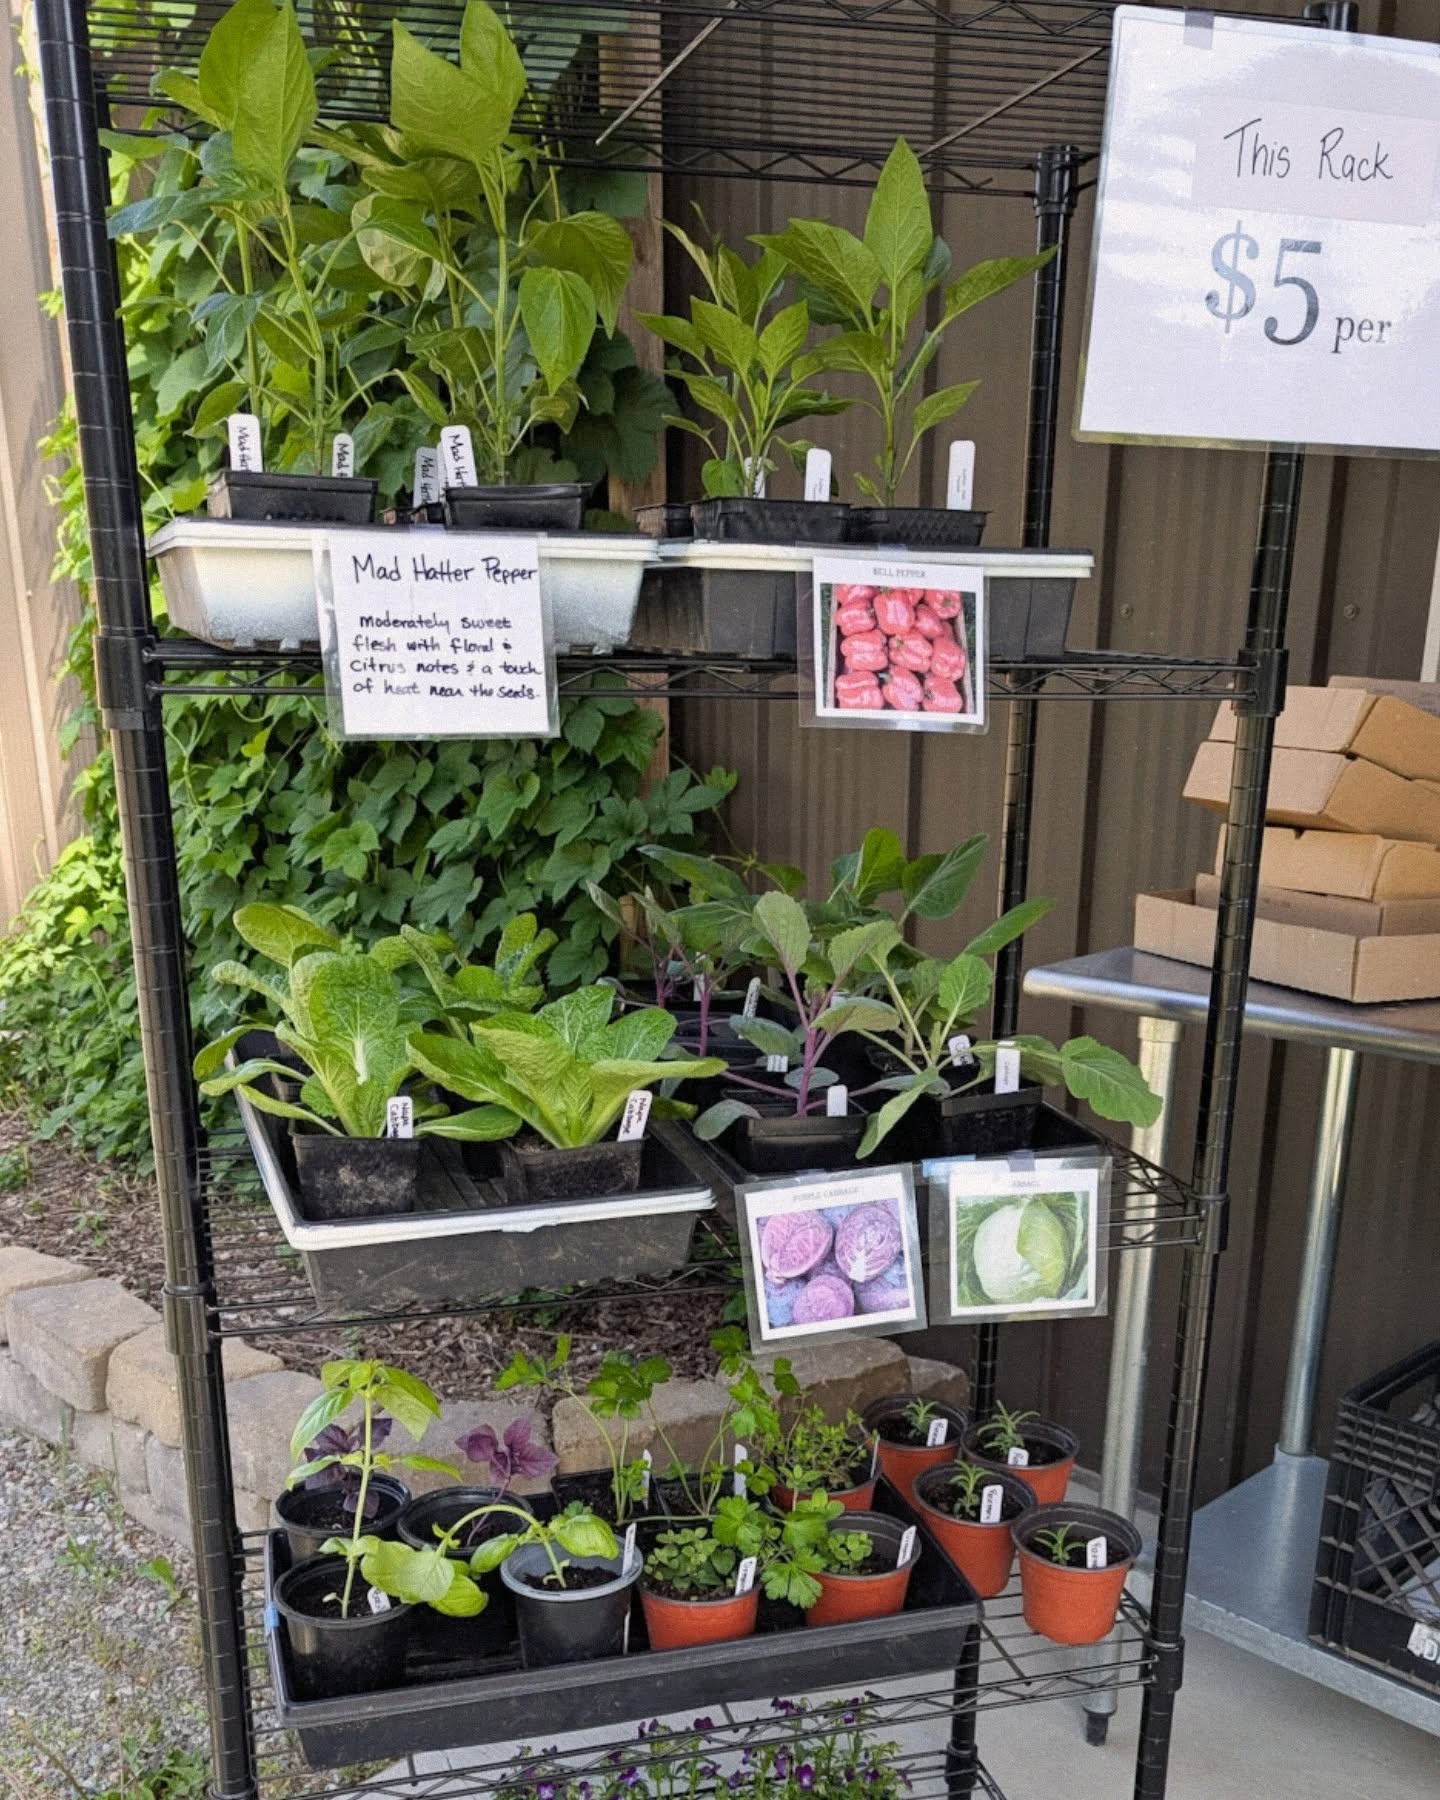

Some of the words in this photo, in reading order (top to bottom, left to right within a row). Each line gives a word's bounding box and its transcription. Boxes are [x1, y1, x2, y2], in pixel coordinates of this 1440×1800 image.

[1223, 118, 1291, 179] This
[1318, 127, 1393, 181] Rack
[1204, 219, 1322, 346] $5
[1331, 313, 1392, 354] per
[352, 553, 401, 584] Mad
[412, 553, 475, 583] Hatter
[481, 556, 538, 585] Pepper
[359, 610, 451, 634] moderately
[460, 616, 512, 629] sweet
[352, 634, 396, 652] flesh
[406, 641, 440, 651] with
[450, 638, 494, 654] floral
[416, 659, 459, 675] notes
[482, 665, 492, 674] a
[500, 661, 542, 676] touch
[384, 679, 420, 696] heat
[429, 684, 464, 697] near
[469, 684, 493, 697] the
